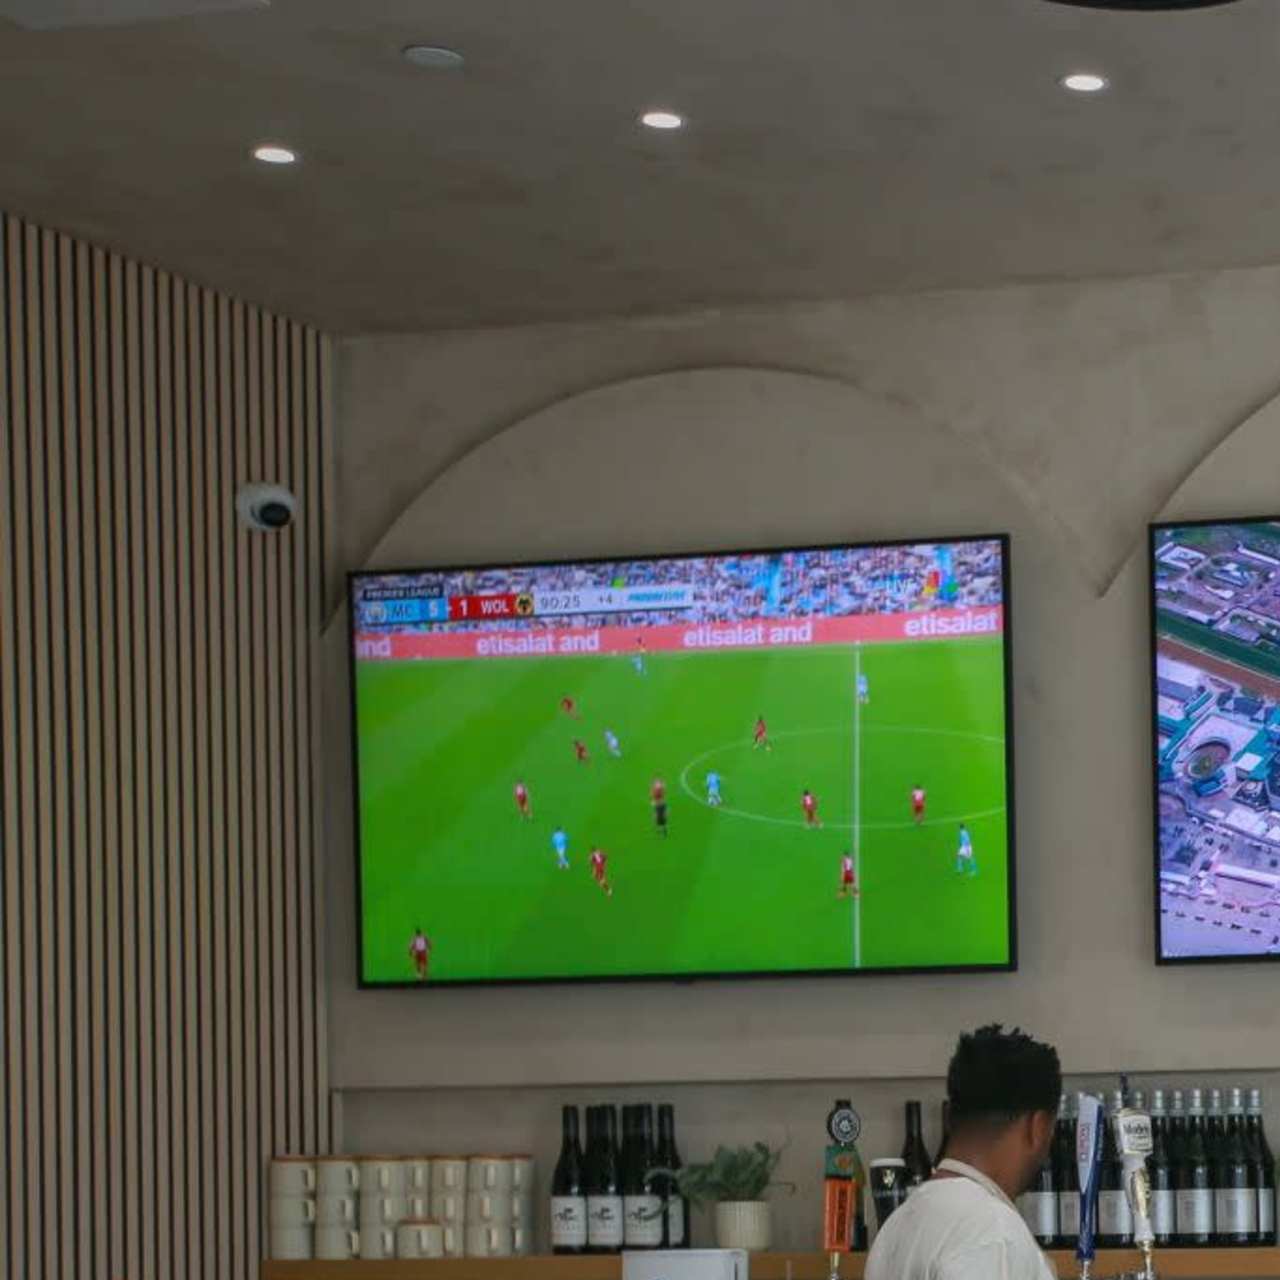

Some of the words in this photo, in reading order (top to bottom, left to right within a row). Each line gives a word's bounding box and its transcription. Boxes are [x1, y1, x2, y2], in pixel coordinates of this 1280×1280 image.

[480, 600, 511, 615] WOL
[683, 624, 764, 647] etisalat
[770, 622, 813, 643] and
[904, 611, 997, 636] etisalat
[476, 634, 554, 656] etisalat
[560, 630, 600, 651] and
